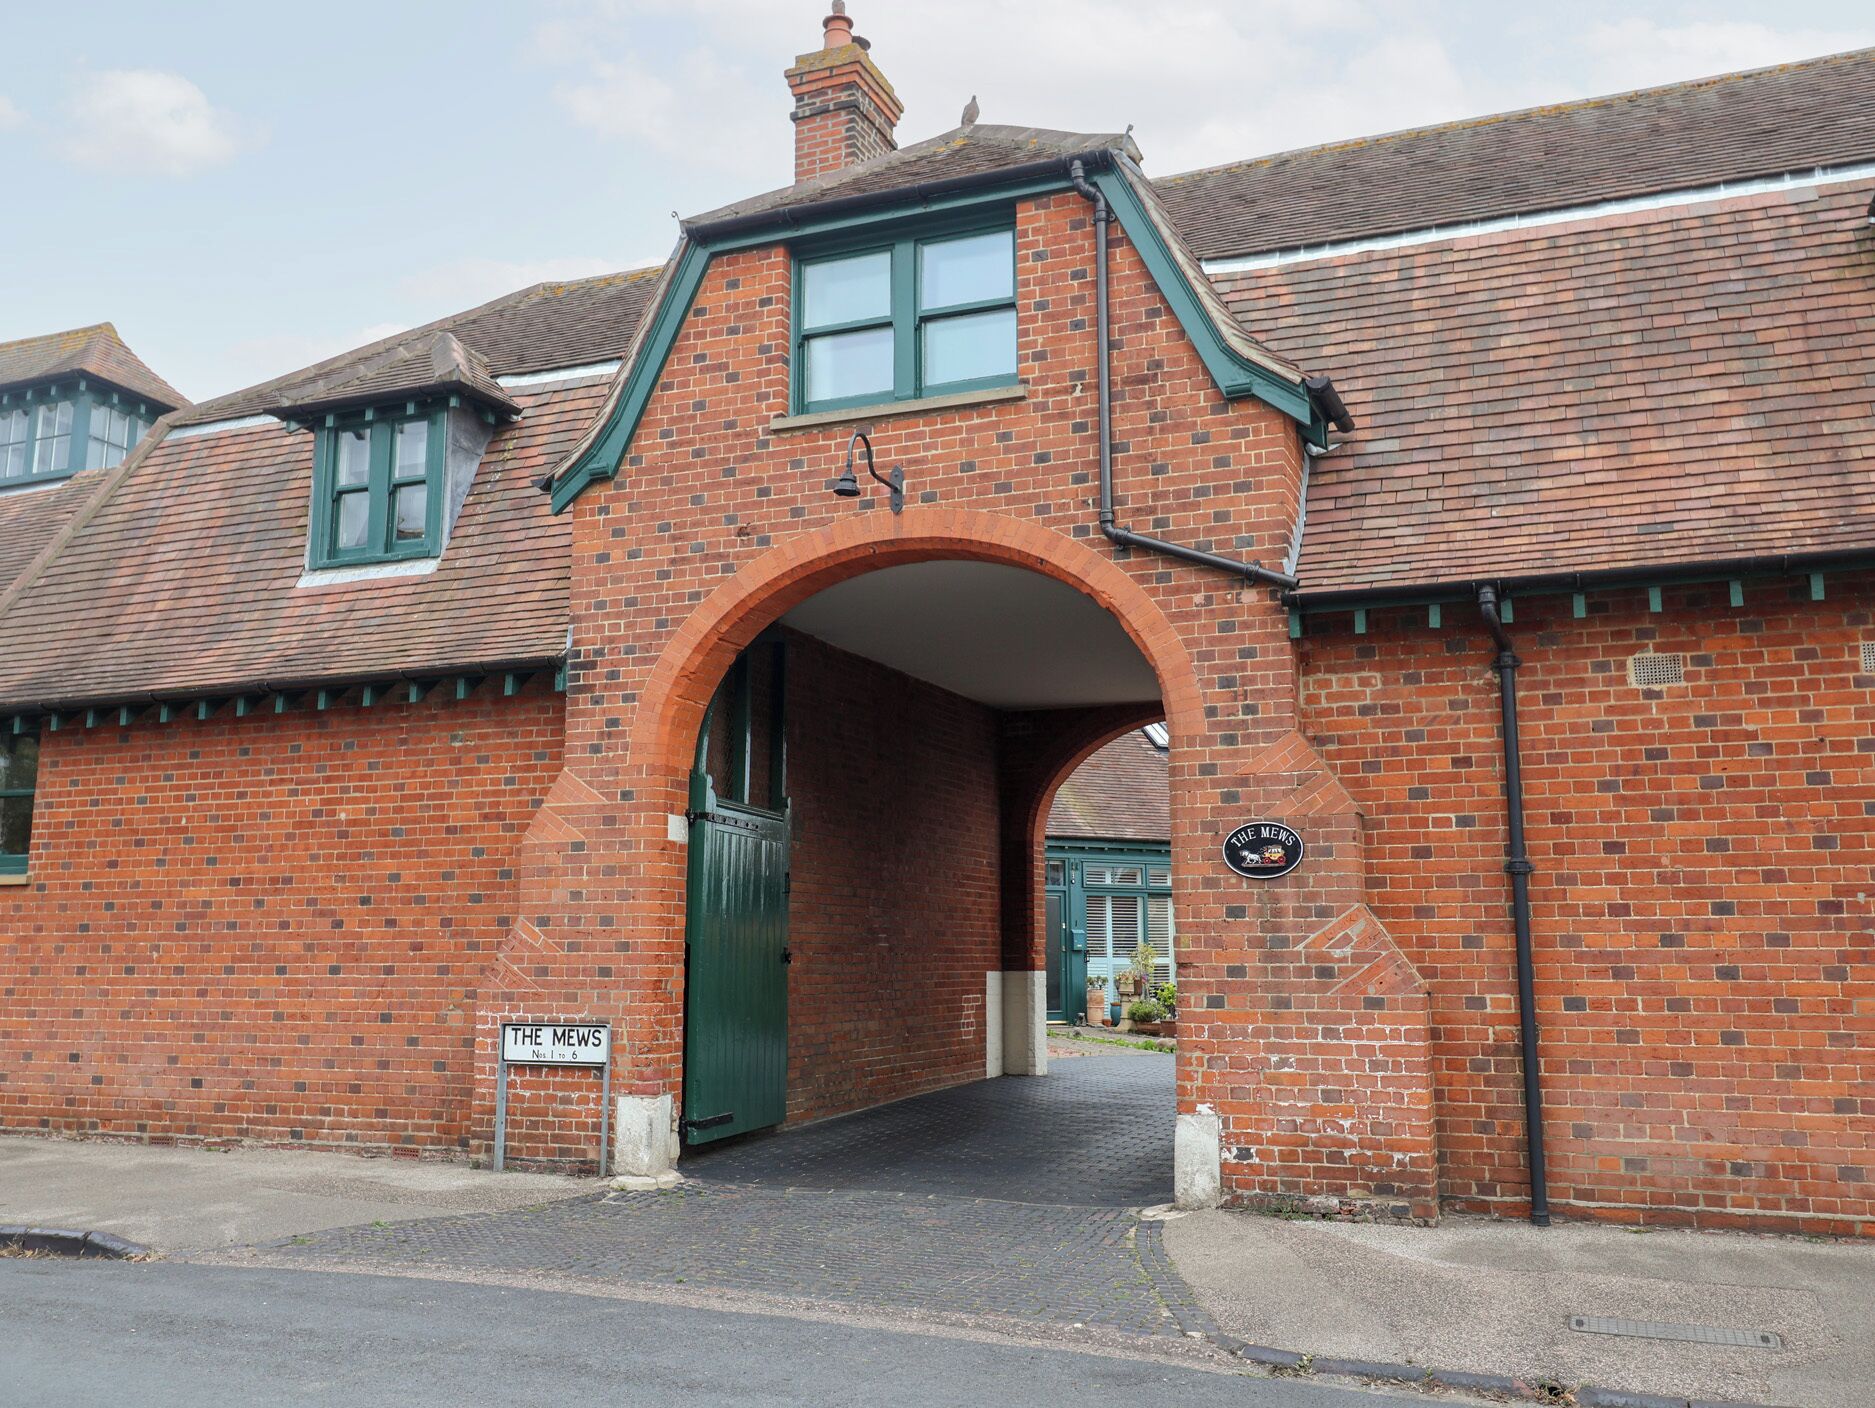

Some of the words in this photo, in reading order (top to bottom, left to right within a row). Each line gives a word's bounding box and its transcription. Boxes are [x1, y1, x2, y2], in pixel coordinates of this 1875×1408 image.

[1230, 828, 1256, 847] THE
[1261, 826, 1296, 846] MEWS
[511, 1028, 542, 1046] THE
[552, 1028, 602, 1047] MEWS
[571, 1050, 578, 1060] 6
